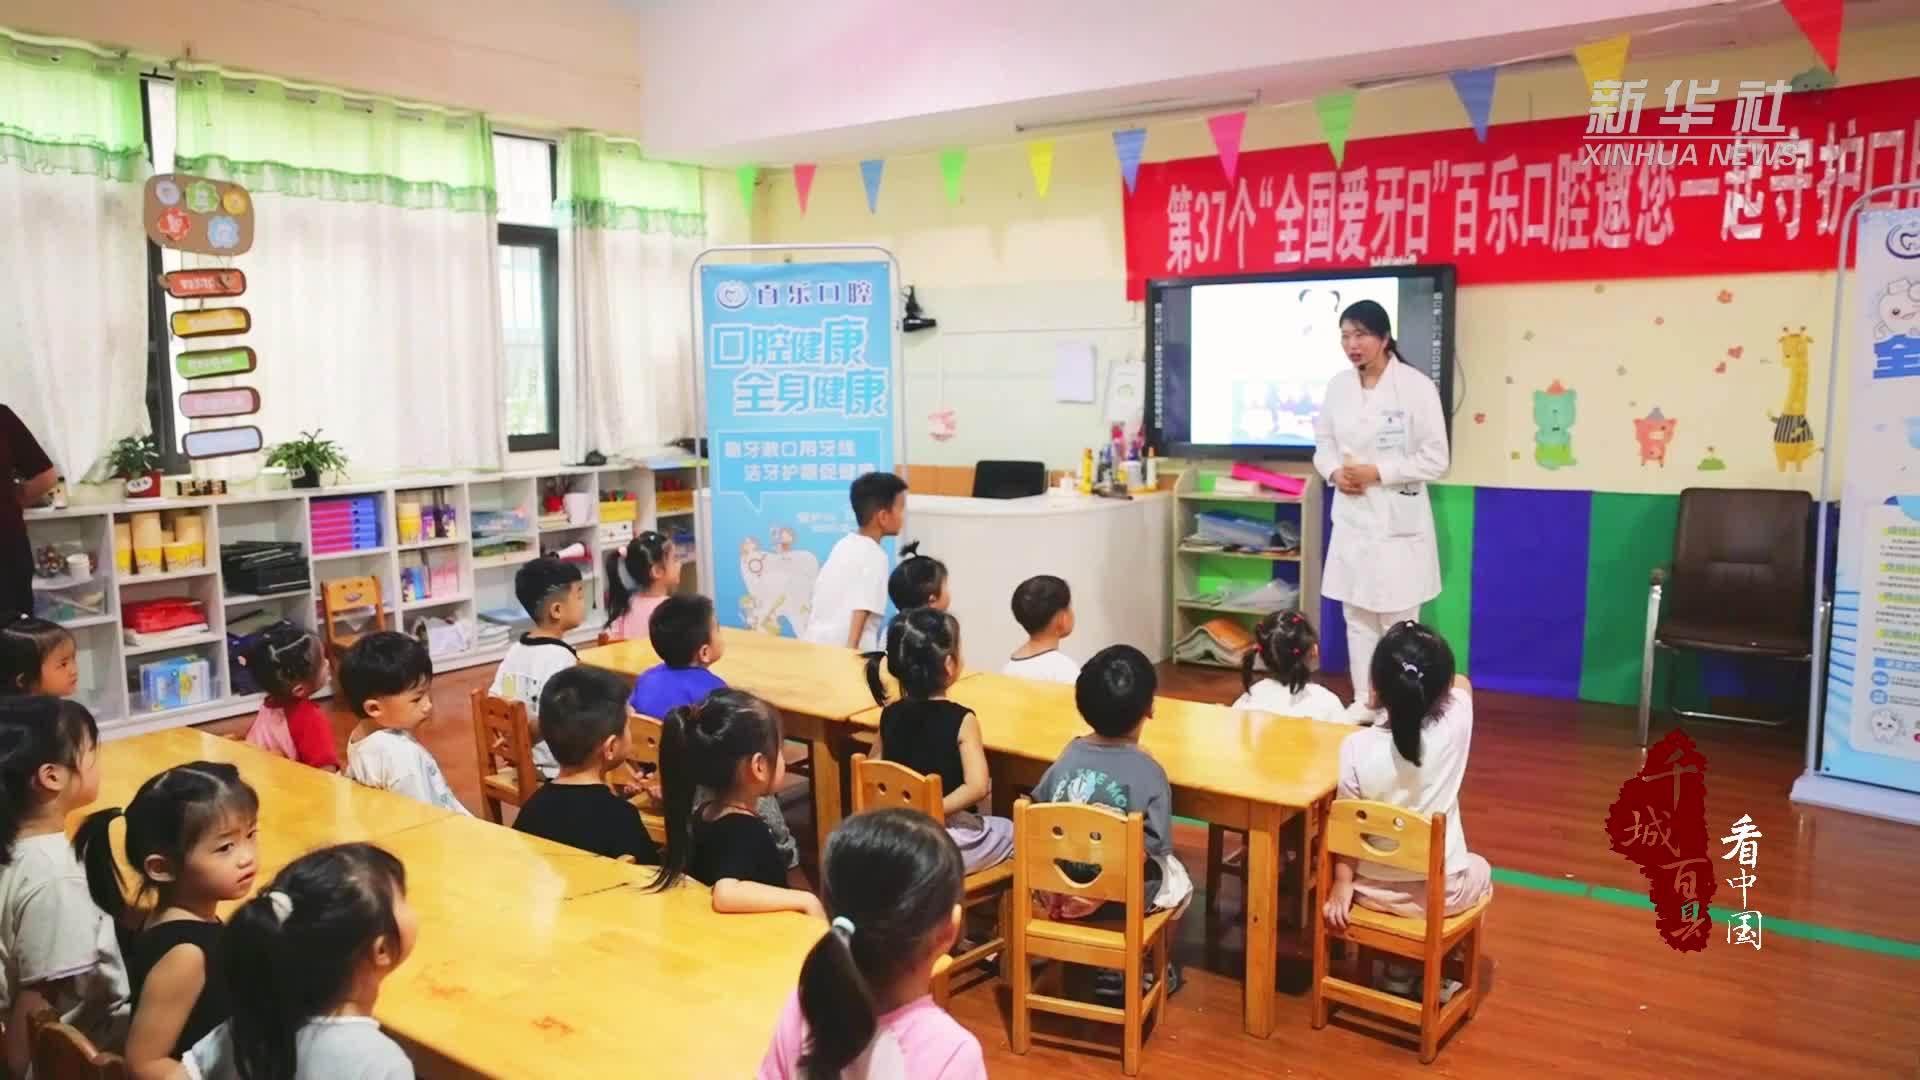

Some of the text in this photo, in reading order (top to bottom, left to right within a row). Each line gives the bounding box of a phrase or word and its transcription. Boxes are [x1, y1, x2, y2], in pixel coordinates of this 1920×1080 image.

[1166, 118, 1920, 274] 第37个“全国爱牙日”百乐口腔邀您一起守护口
[711, 316, 868, 367] 口腔健康
[732, 368, 889, 418] 全身健康
